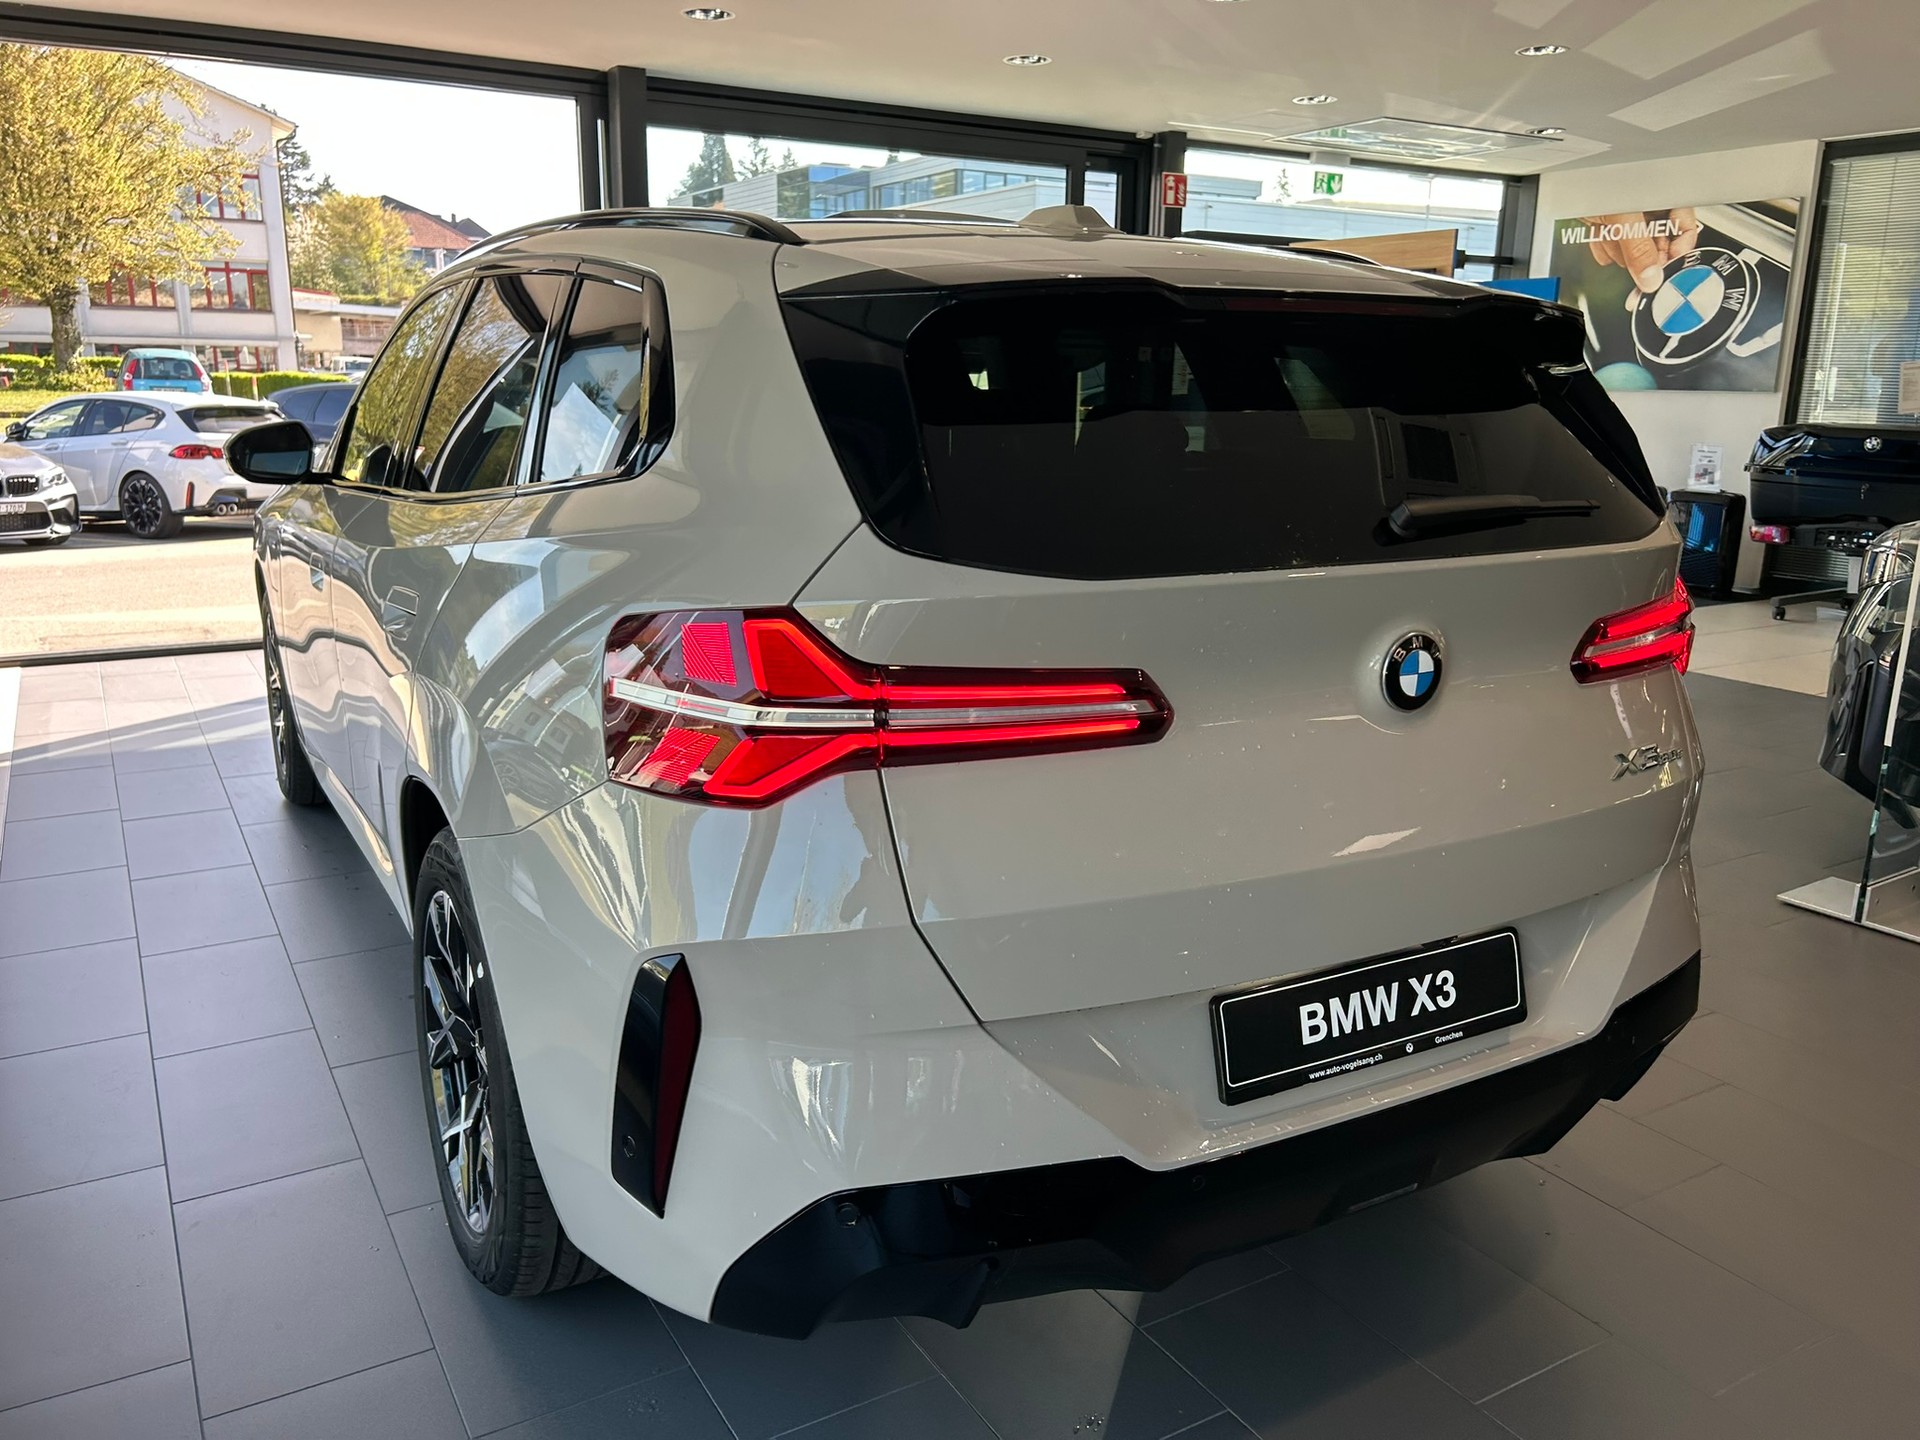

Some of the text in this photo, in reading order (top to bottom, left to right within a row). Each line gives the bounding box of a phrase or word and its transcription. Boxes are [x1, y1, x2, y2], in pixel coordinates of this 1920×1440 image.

[1561, 219, 1683, 244] WILLKOMMEN.
[1681, 250, 1746, 312] BMW
[1299, 969, 1457, 1046] BMW X3
[1308, 1030, 1464, 1080] www.auto-vogelsang.ch Grenchen
